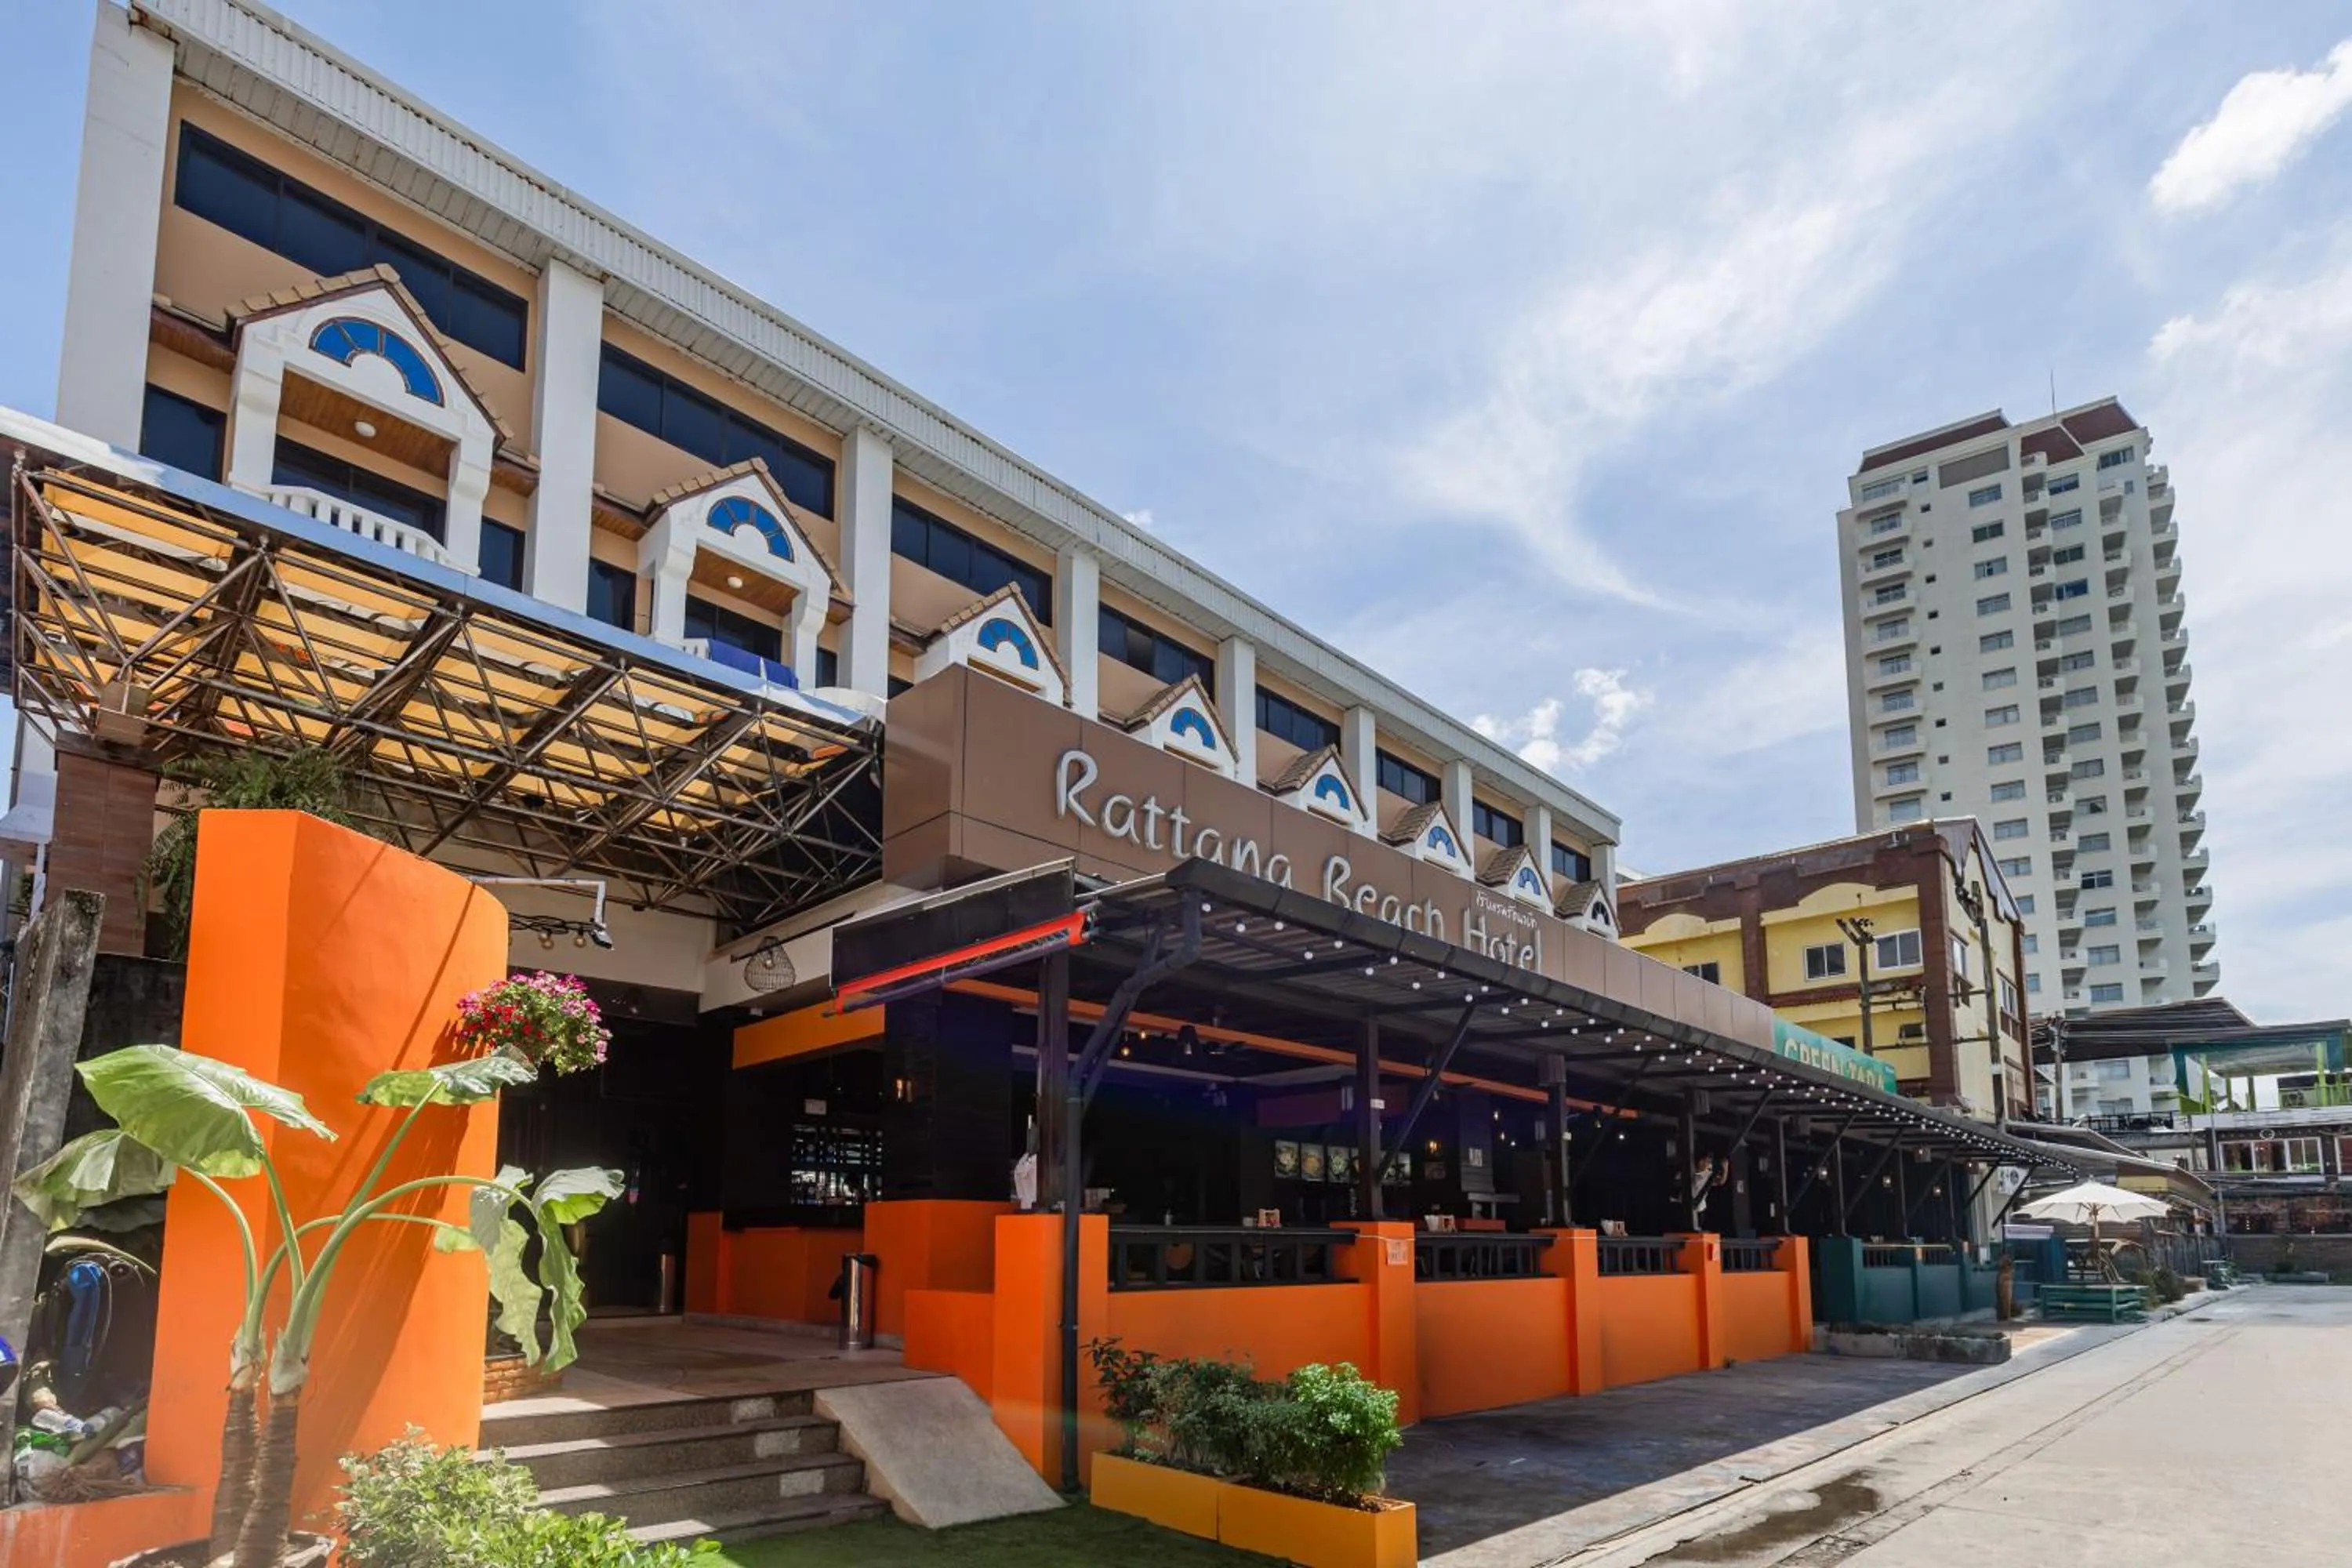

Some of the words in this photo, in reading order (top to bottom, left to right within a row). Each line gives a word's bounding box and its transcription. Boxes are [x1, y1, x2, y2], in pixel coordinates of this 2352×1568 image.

[1055, 750, 1292, 887] Rattana
[1325, 855, 1445, 941] Beach
[1464, 907, 1541, 974] Hotel
